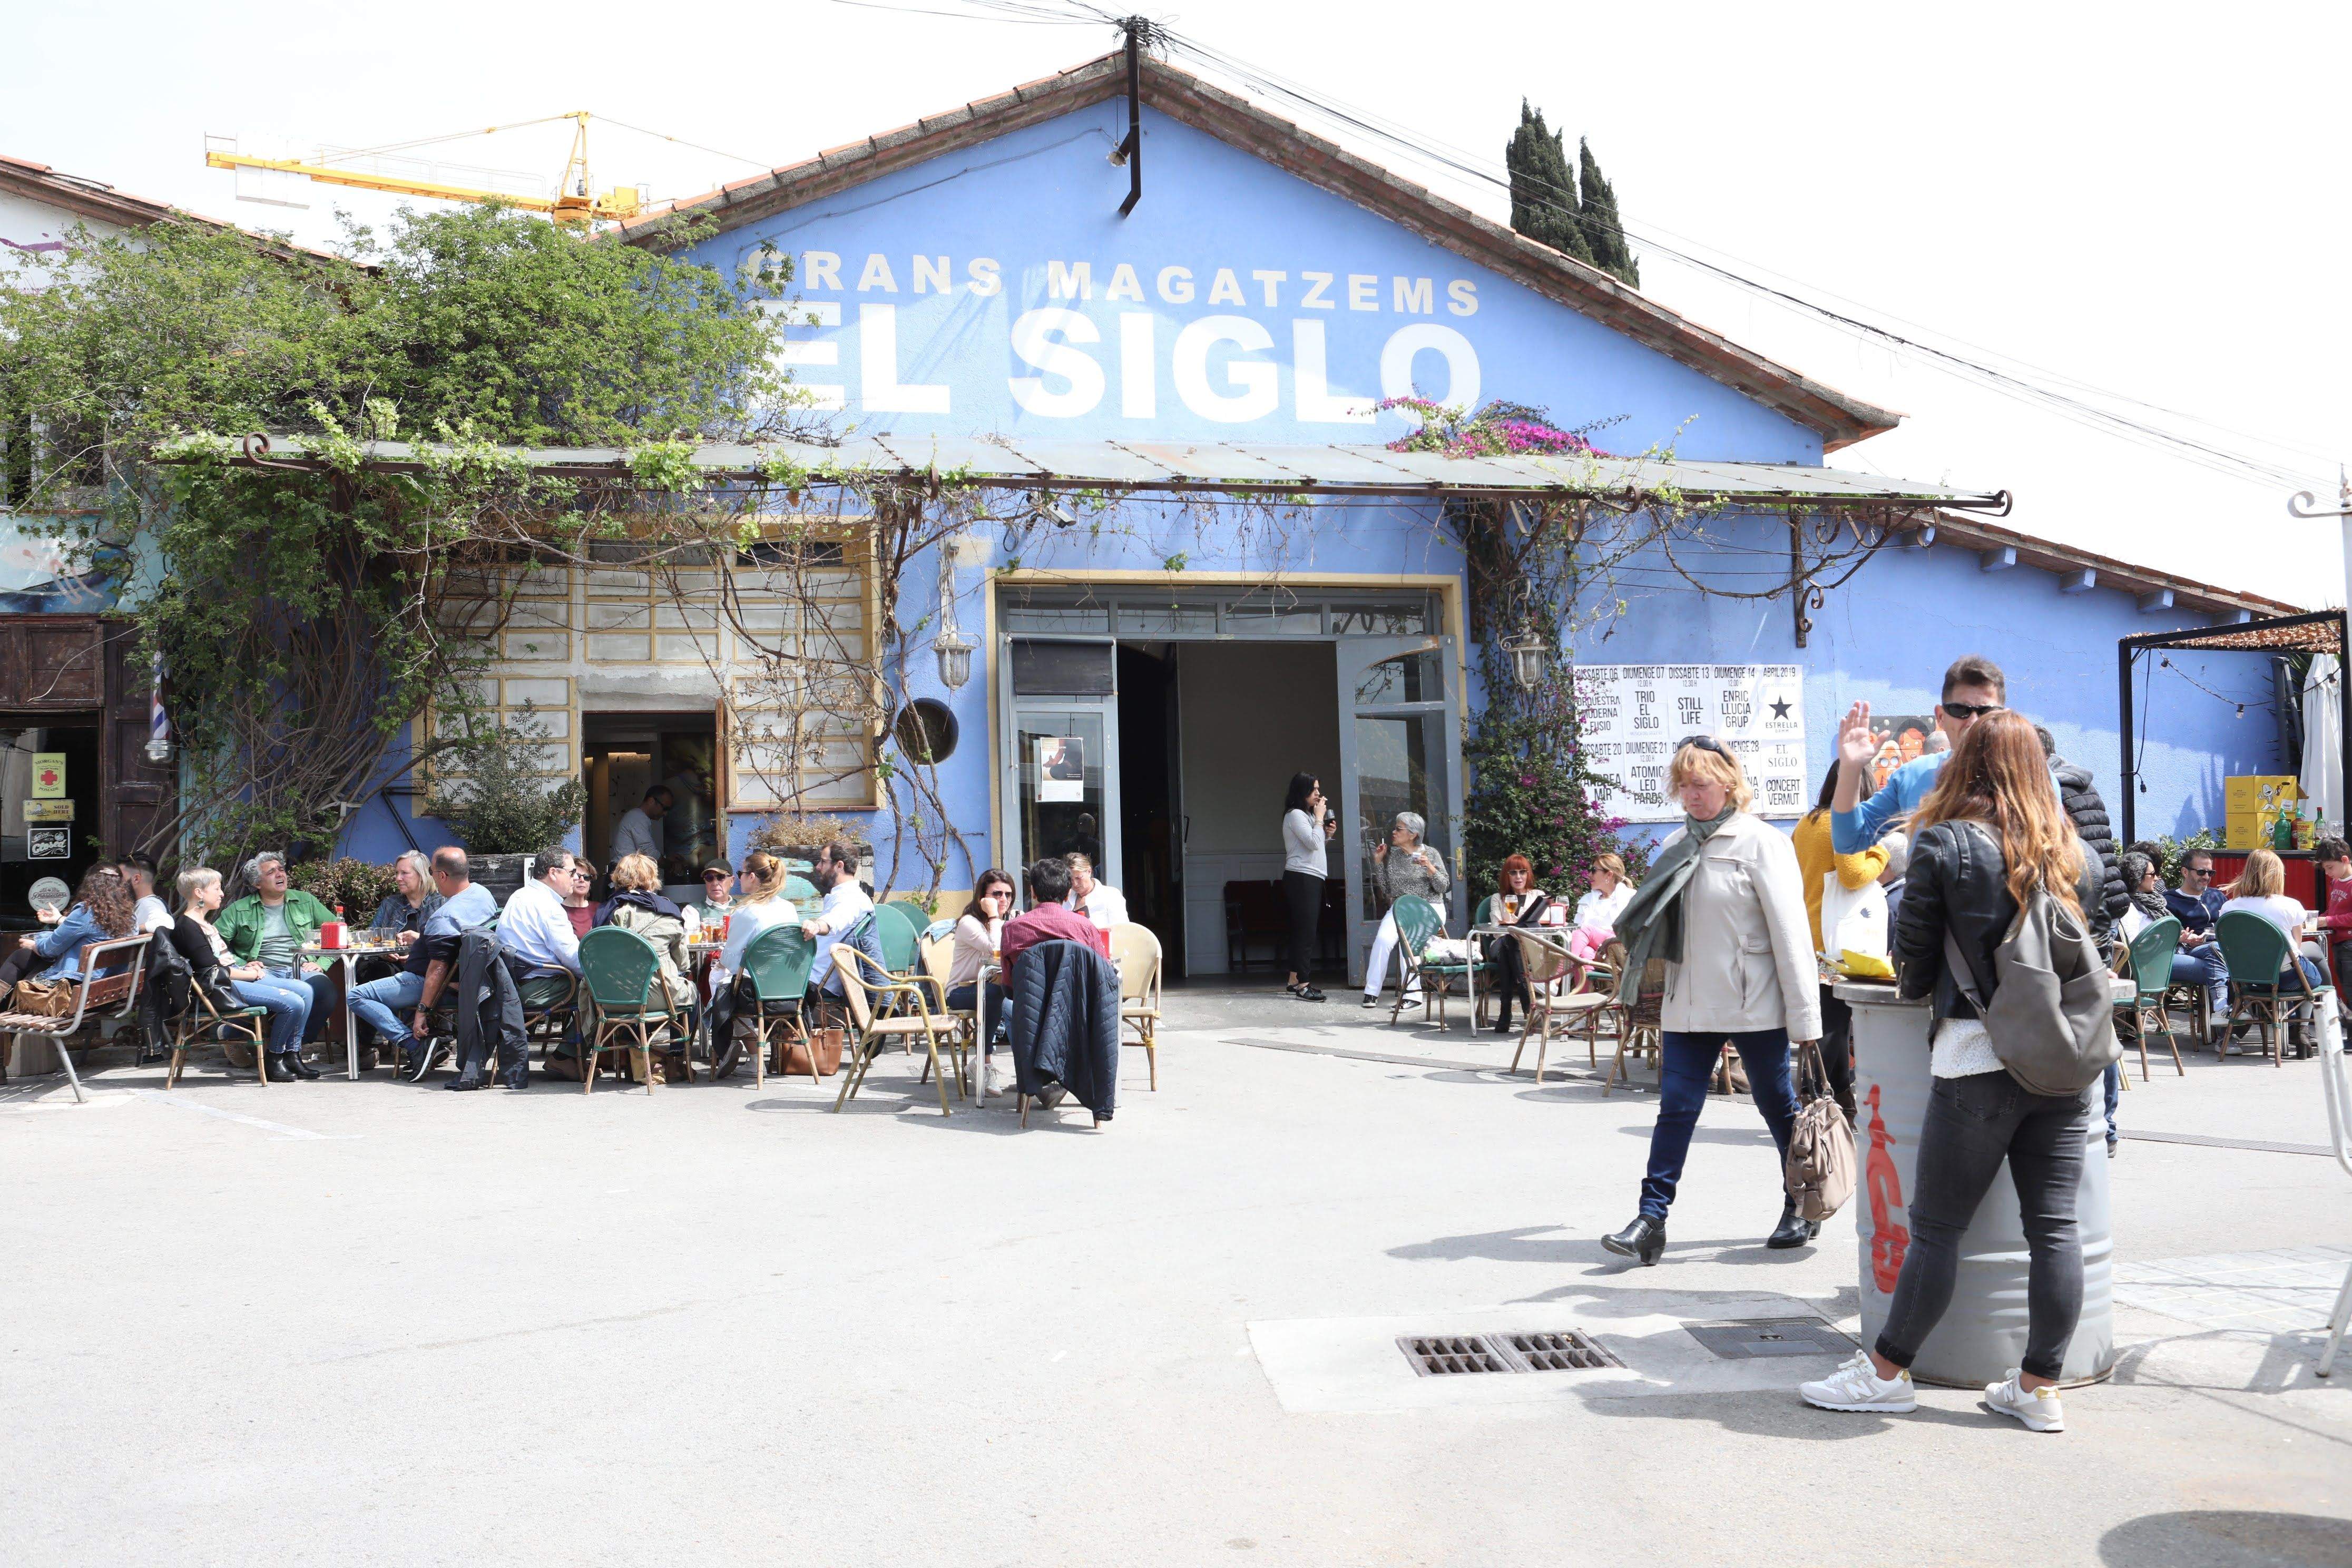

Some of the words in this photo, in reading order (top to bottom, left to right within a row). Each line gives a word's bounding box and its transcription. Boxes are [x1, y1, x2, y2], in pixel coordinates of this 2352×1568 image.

[747, 249, 1001, 297] GRANS
[1047, 260, 1479, 316] MAGATZEMS
[748, 300, 950, 414] EL
[1008, 309, 1481, 429] SIGLO
[1576, 668, 1608, 680] DISSABTE
[1610, 668, 1618, 680] 06
[1623, 667, 1654, 679] DIUMENGE
[1657, 667, 1664, 679] 07
[1669, 667, 1700, 679] DISSABTE
[1702, 667, 1709, 678] 13
[1714, 667, 1746, 679] DIUMENGE
[1748, 667, 1755, 678] 14
[1763, 667, 1780, 677] ABRIL
[1781, 667, 1796, 677] 2019
[1577, 696, 1621, 706] ORQUESTRA
[1635, 691, 1655, 703] TRIO
[1723, 690, 1749, 702] ENRIC
[1678, 697, 1703, 710] STILL
[1721, 703, 1751, 715] LLUCIA
[1581, 708, 1618, 718] MODERNA
[1640, 704, 1650, 716] EL
[1634, 717, 1659, 729] SIGLO
[1681, 711, 1701, 724] LIFE
[1726, 716, 1749, 728] GRUP
[1590, 721, 1611, 731] FUSIO
[1580, 743, 1611, 756] DISSABTE
[1613, 743, 1622, 755] 20
[1626, 742, 1658, 753] DIUMENGE
[1659, 742, 1667, 753] 21
[1751, 740, 1759, 752] 28
[1776, 744, 1788, 754] EL
[1768, 757, 1797, 767] SIGLO
[1631, 766, 1664, 778] ATOMIC
[1640, 779, 1656, 791] LEO
[1766, 779, 1800, 792] CONCERT
[1594, 788, 1612, 801] MIR
[1768, 793, 1800, 805] VERMUT
[32, 839, 67, 854] Closed
